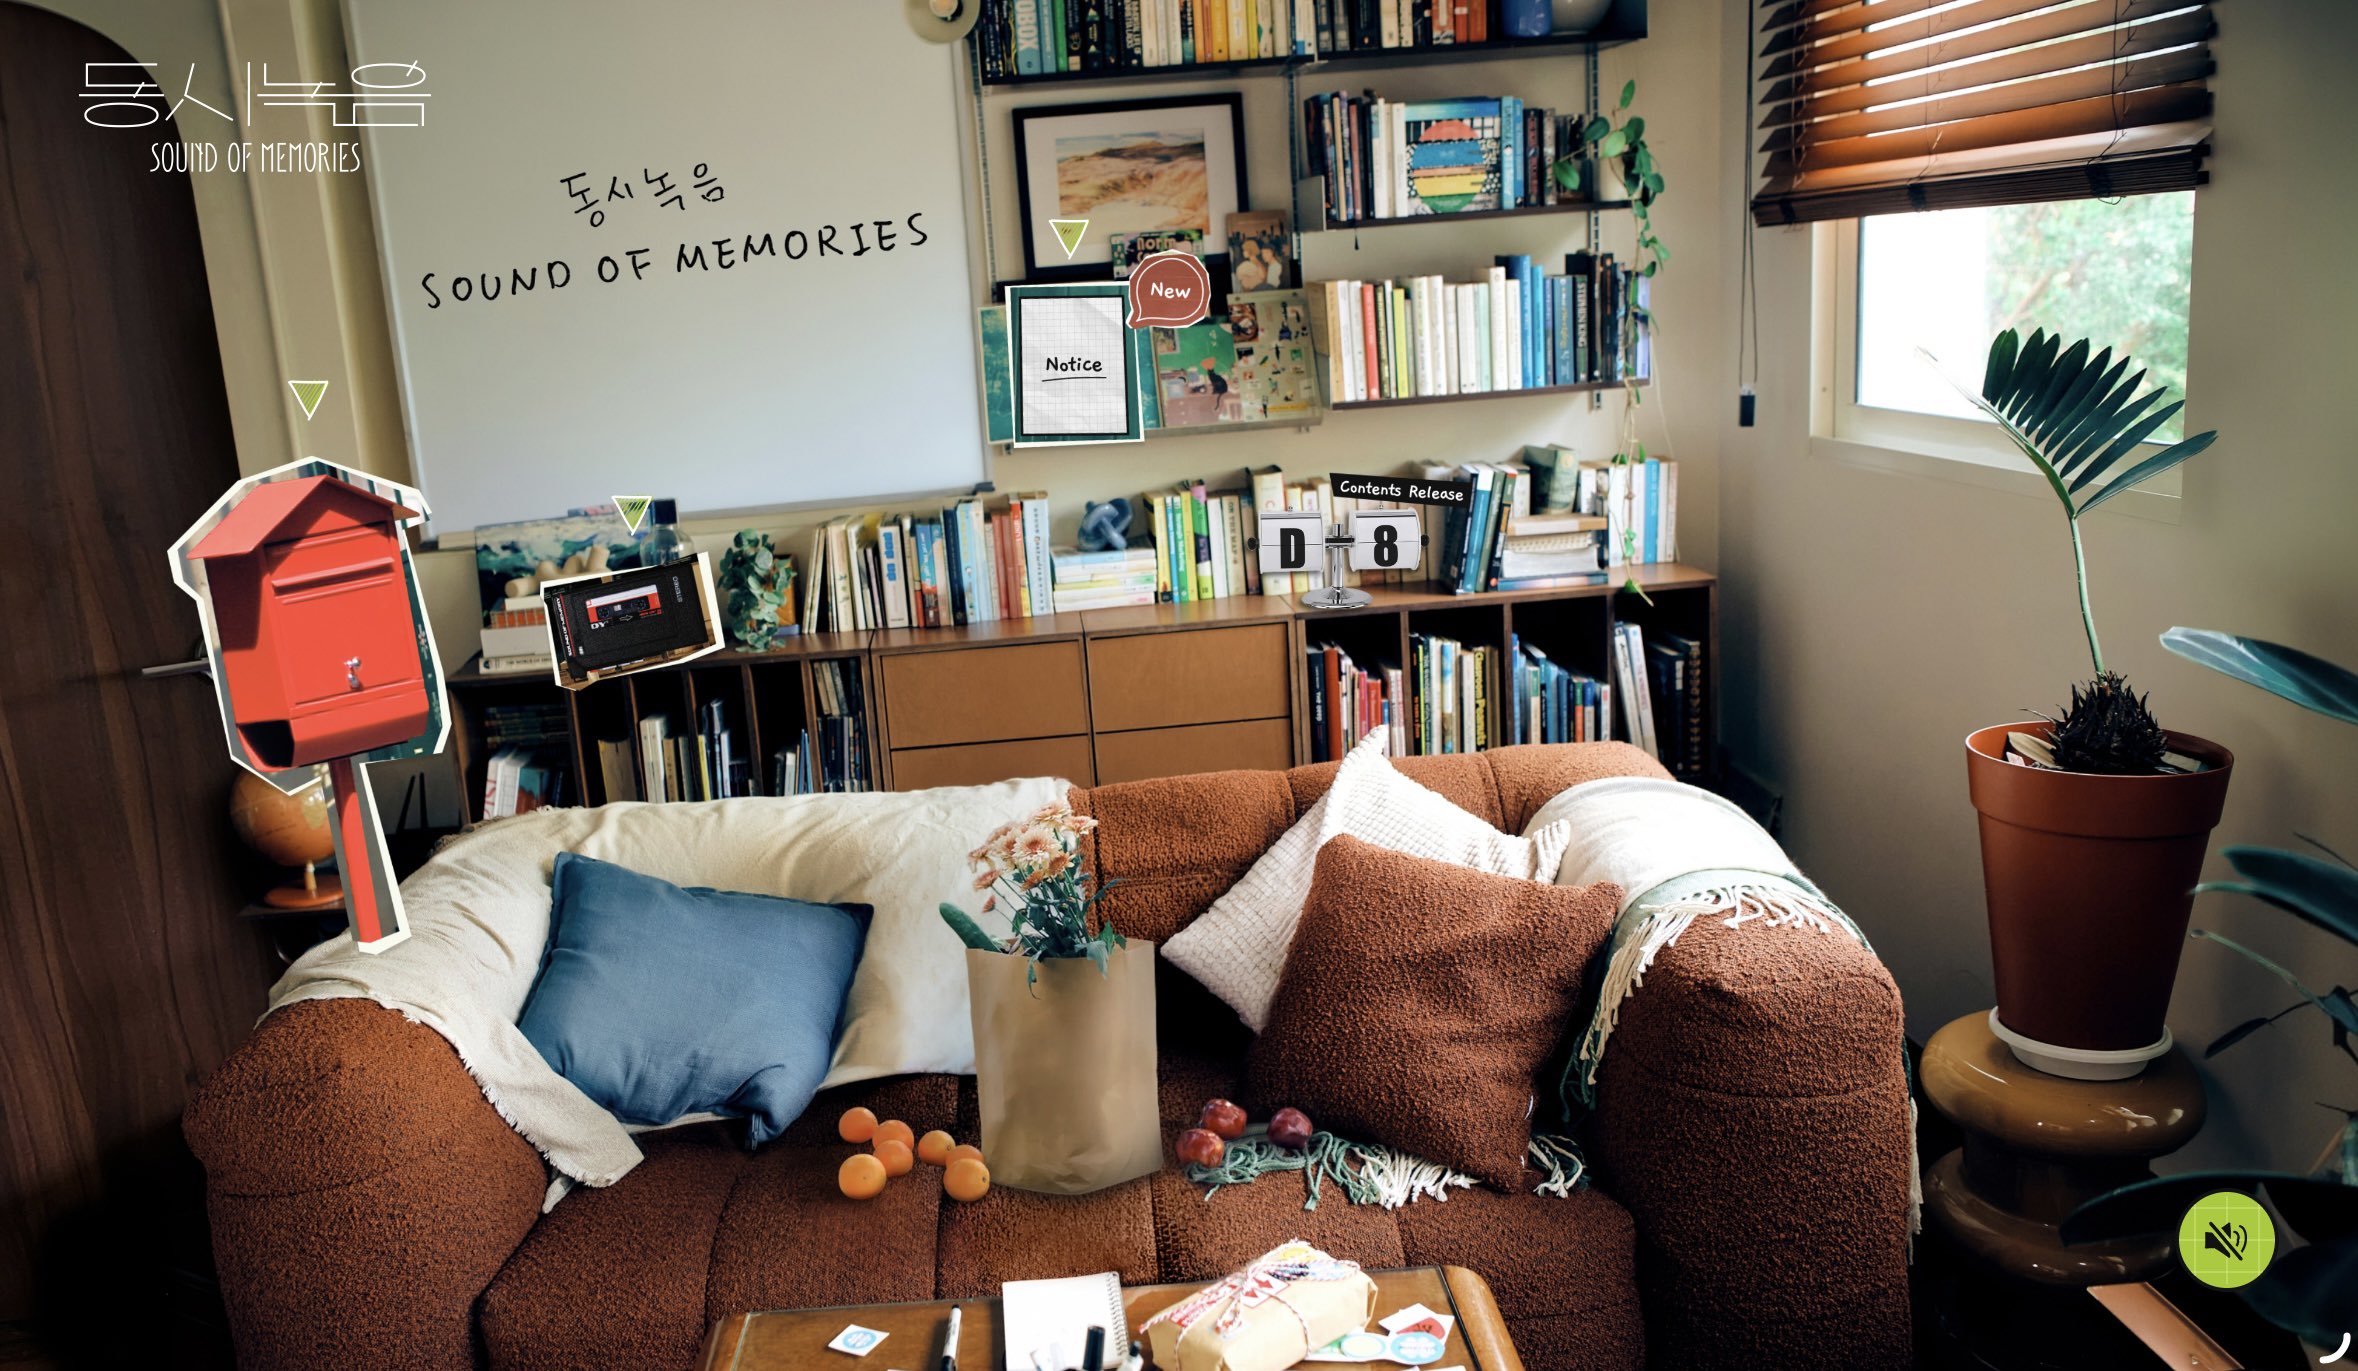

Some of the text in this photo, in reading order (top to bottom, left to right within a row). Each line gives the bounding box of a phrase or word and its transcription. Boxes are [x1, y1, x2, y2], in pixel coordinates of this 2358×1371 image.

[560, 163, 725, 228] 동시녹음
[421, 212, 929, 309] SOUND OF MEMORIES
[1045, 356, 1103, 372] Notice
[1280, 524, 1399, 568] D 8
